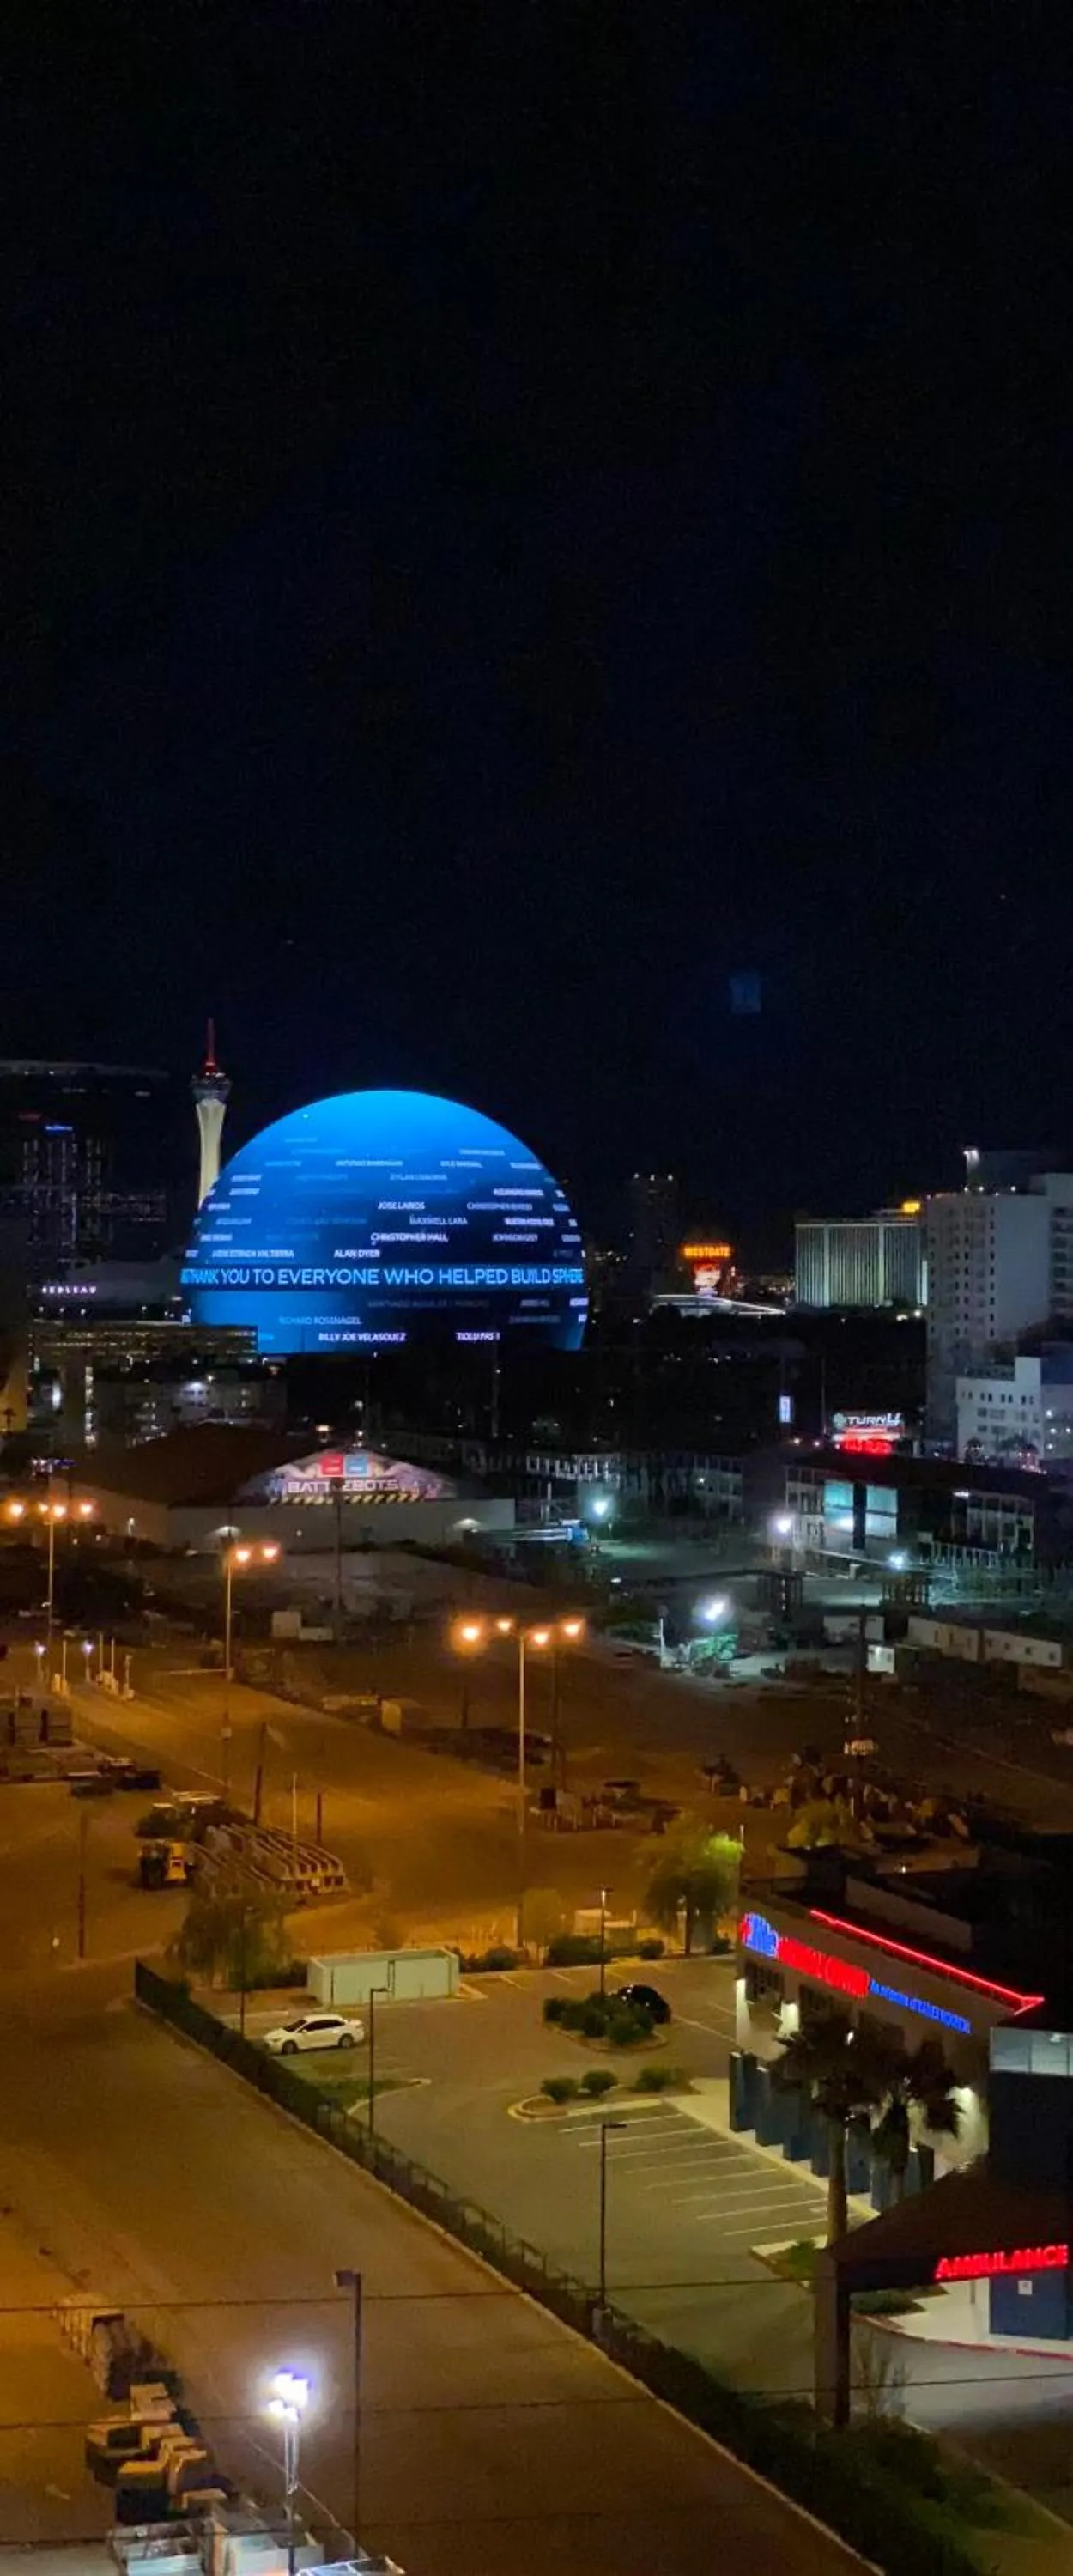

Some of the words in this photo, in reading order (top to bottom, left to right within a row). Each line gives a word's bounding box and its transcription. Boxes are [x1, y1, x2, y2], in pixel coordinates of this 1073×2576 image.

[334, 1249, 356, 1258] ALAN
[684, 1246, 731, 1258] WESTGATE
[221, 1268, 250, 1285] YOU
[252, 1268, 275, 1285] TO
[277, 1268, 380, 1285] EVERYONE
[384, 1268, 434, 1285] WHO
[439, 1268, 508, 1285] HELPED
[511, 1268, 550, 1285] BUILD
[318, 1332, 341, 1341] BILLY
[934, 2243, 1069, 2280] AMBULANCE
